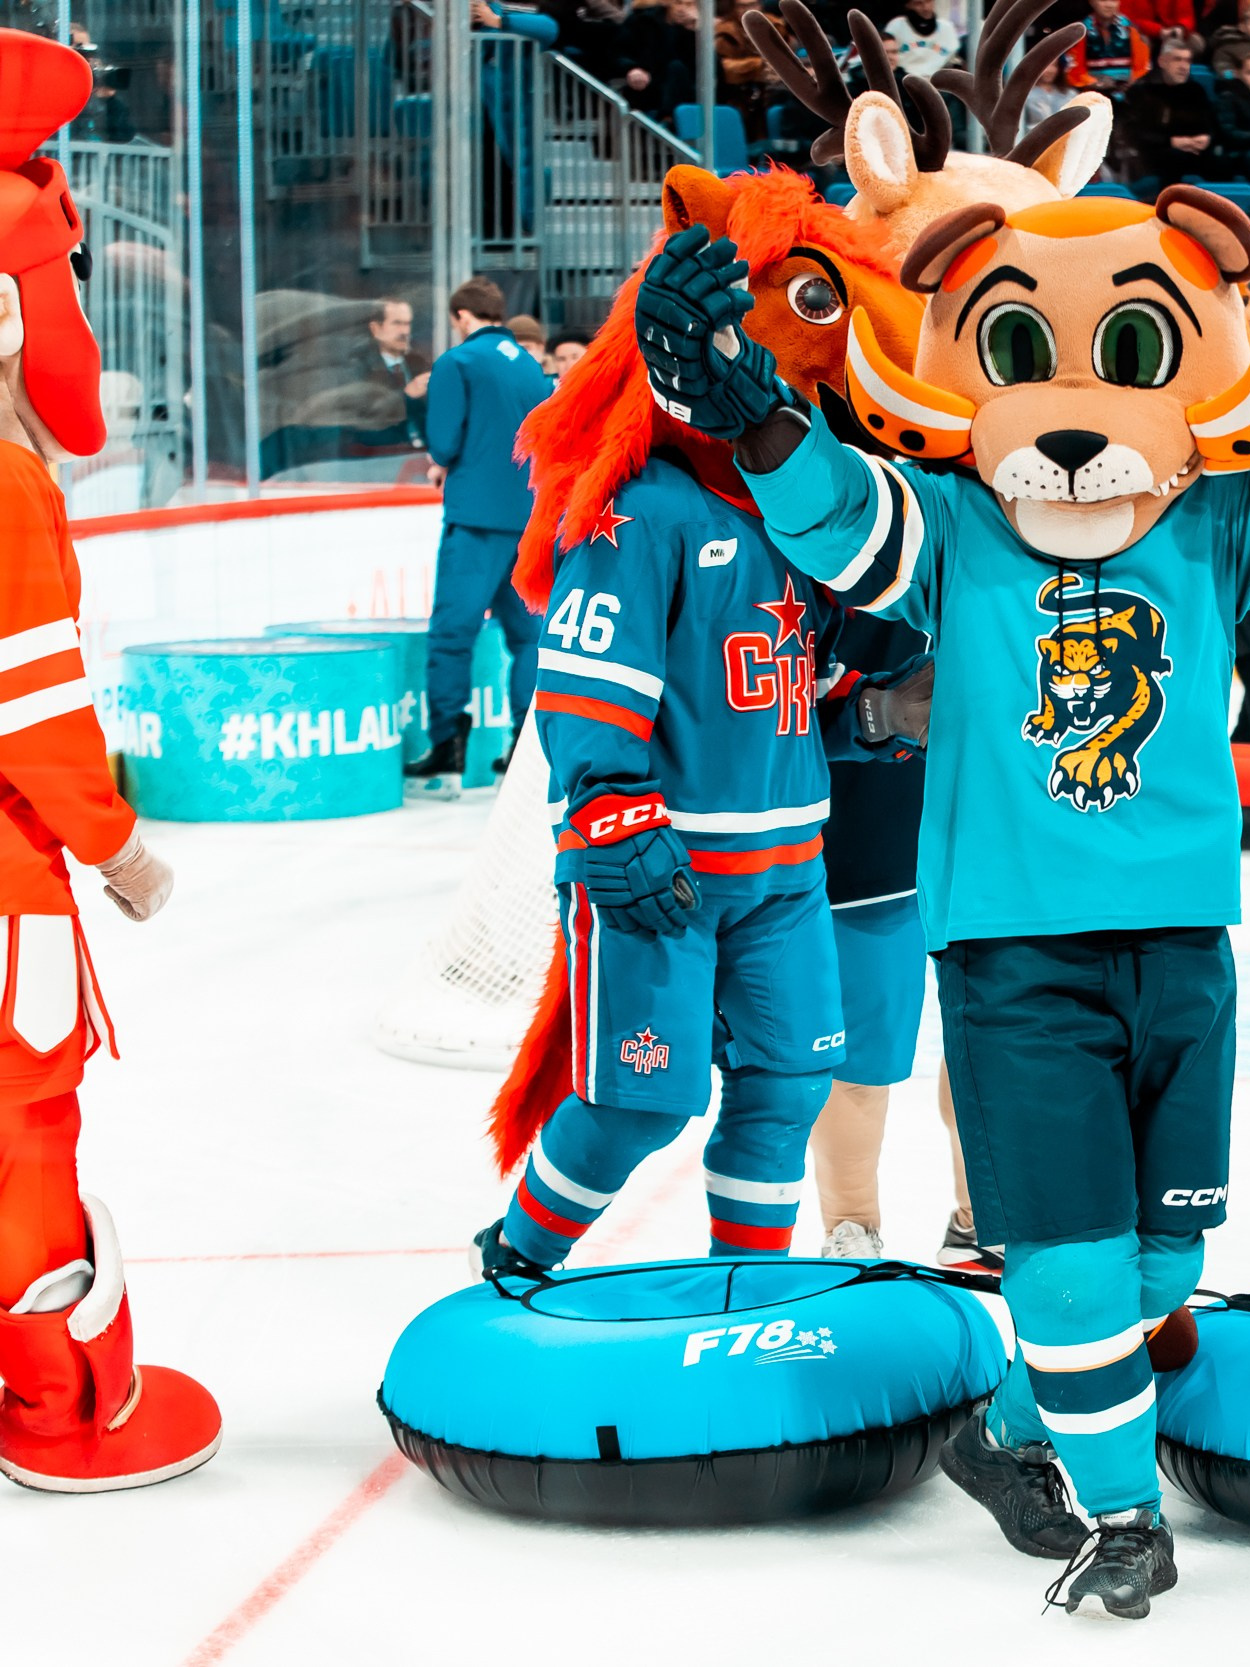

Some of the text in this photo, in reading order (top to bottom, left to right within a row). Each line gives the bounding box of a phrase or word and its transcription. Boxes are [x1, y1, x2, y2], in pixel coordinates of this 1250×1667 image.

[547, 588, 621, 653] 46
[620, 1039, 670, 1075] СКА
[1161, 1184, 1228, 1207] CCM
[683, 1319, 796, 1367] F78
